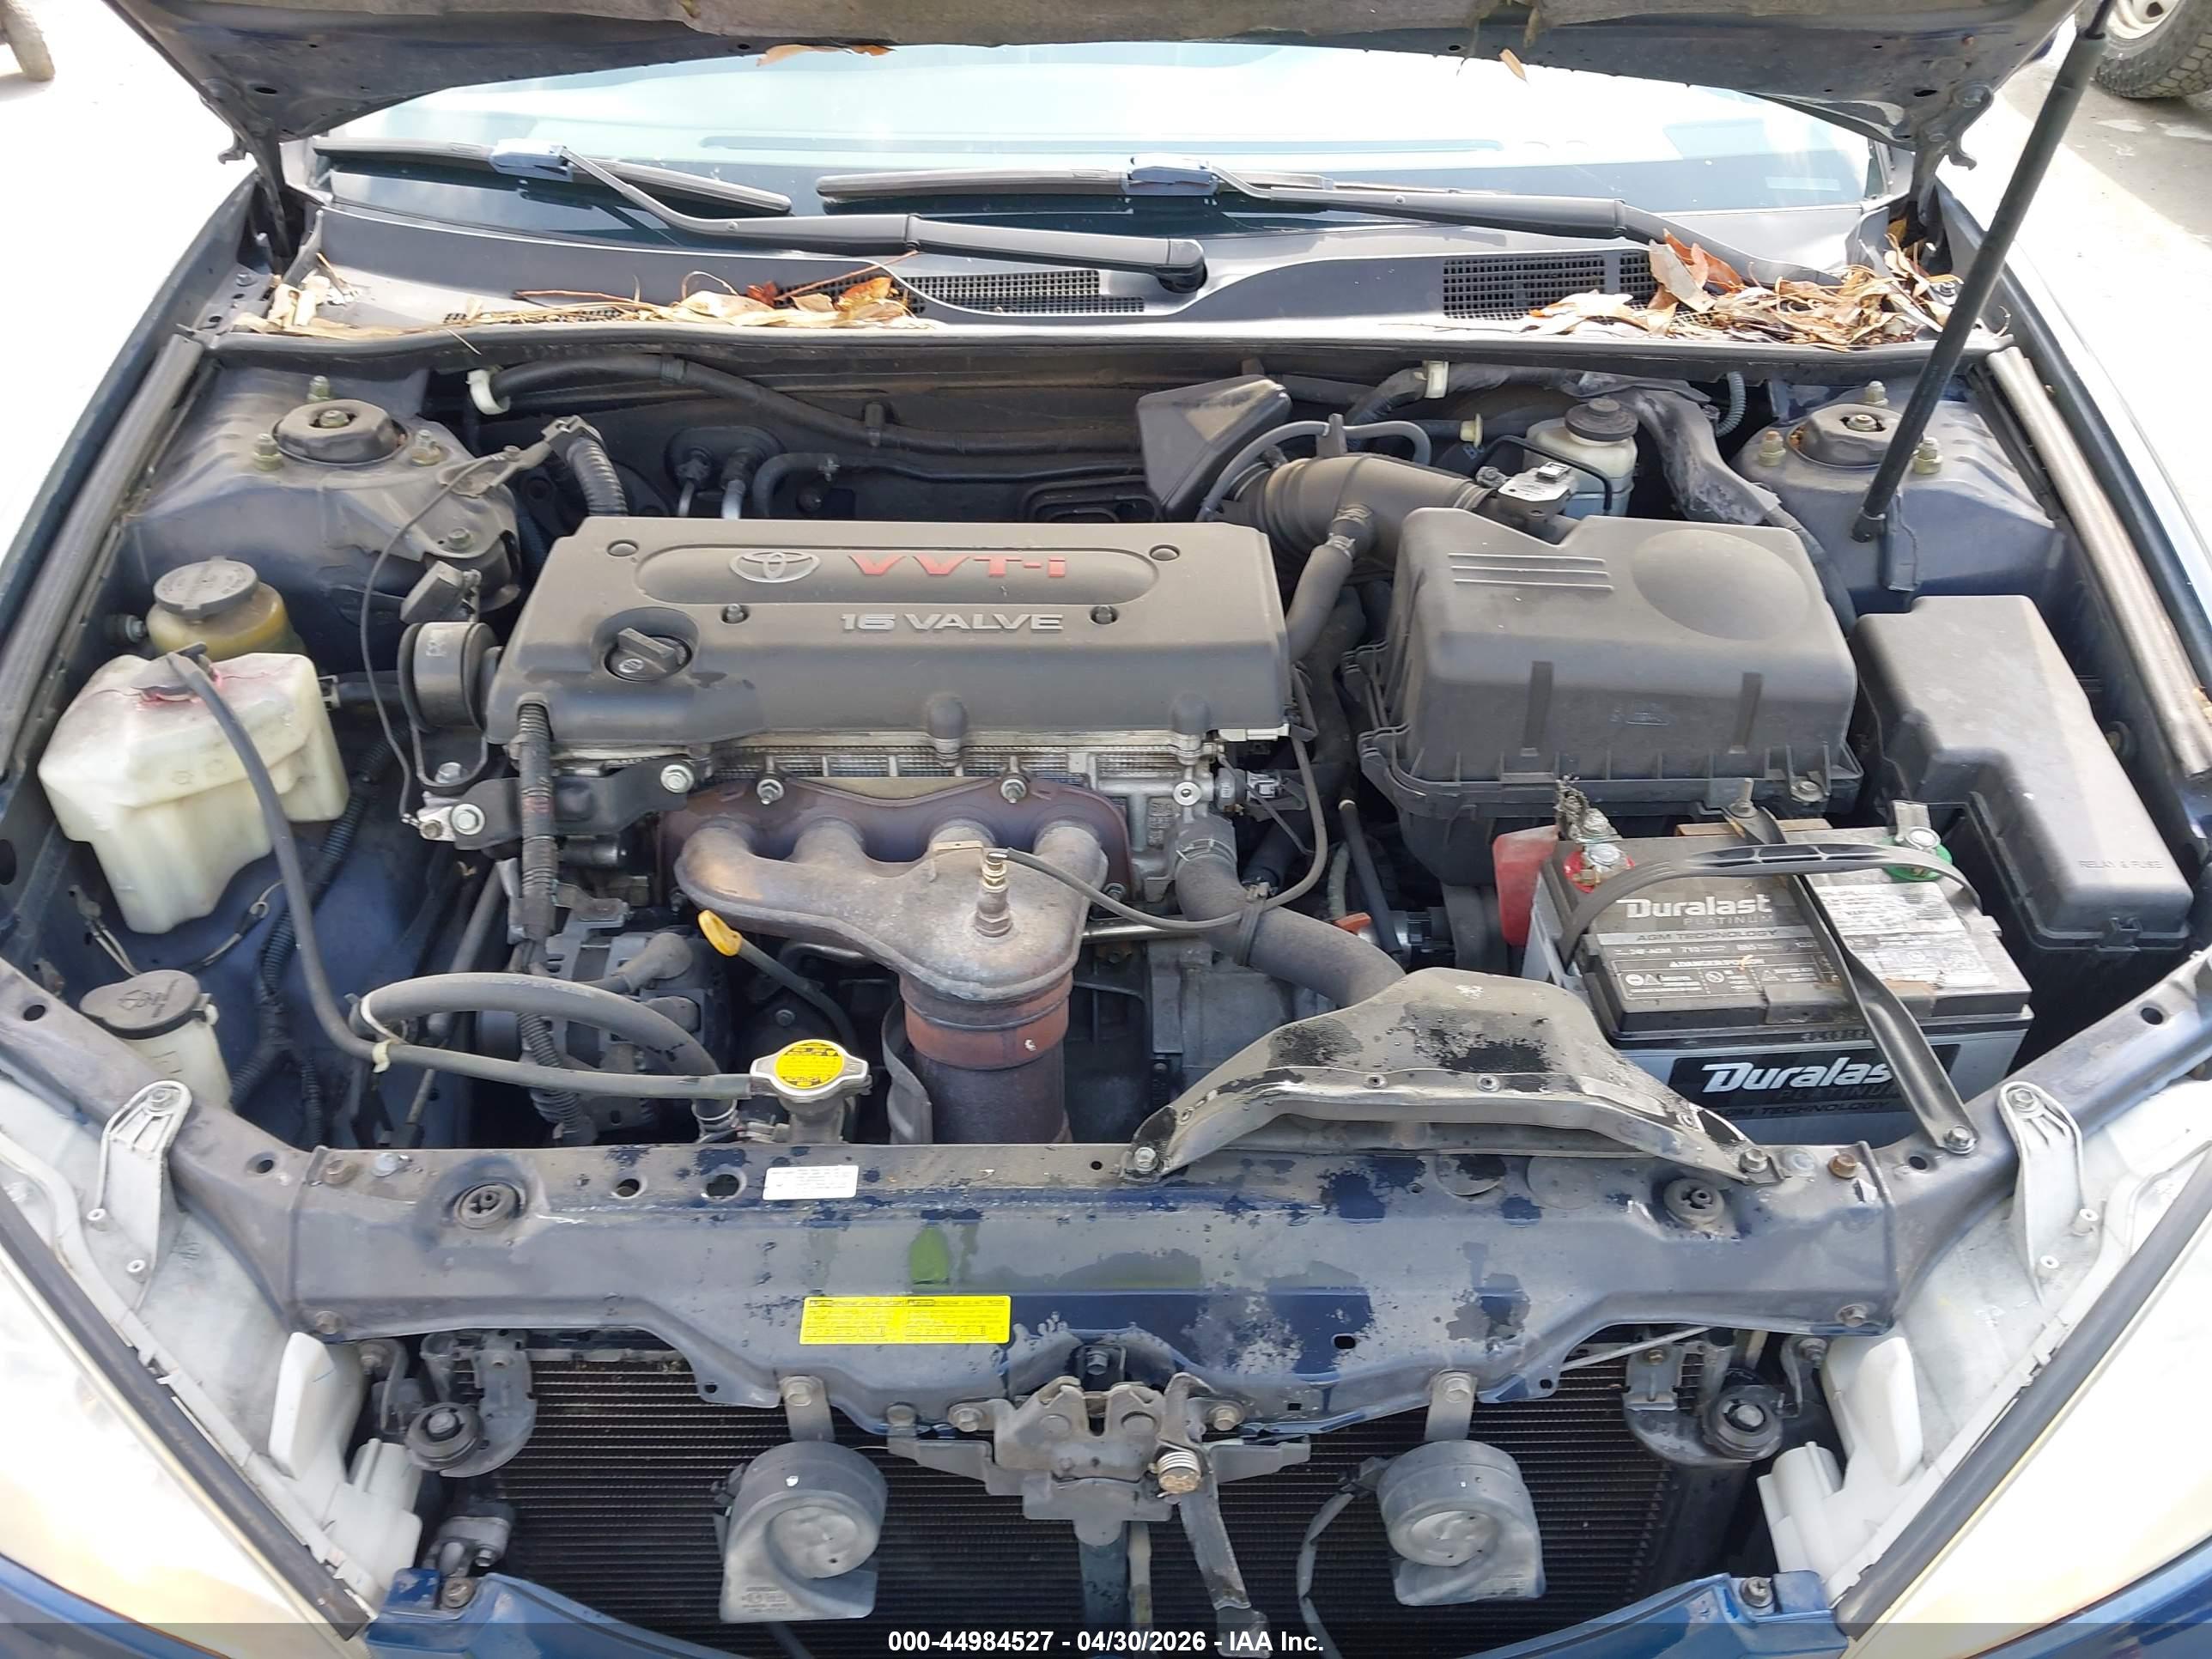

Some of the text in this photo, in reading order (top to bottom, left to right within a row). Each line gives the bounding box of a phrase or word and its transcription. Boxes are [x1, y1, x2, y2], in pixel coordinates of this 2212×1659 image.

[841, 613, 1064, 631] 16 VALVE
[1616, 894, 1773, 918] Duralast
[1683, 915, 1774, 926] PLATINUM
[1637, 929, 1778, 942] AGM TECHNOLOGY
[1702, 1057, 1893, 1093] Duralas
[1761, 1102, 1889, 1115] TECHNOLOGY
